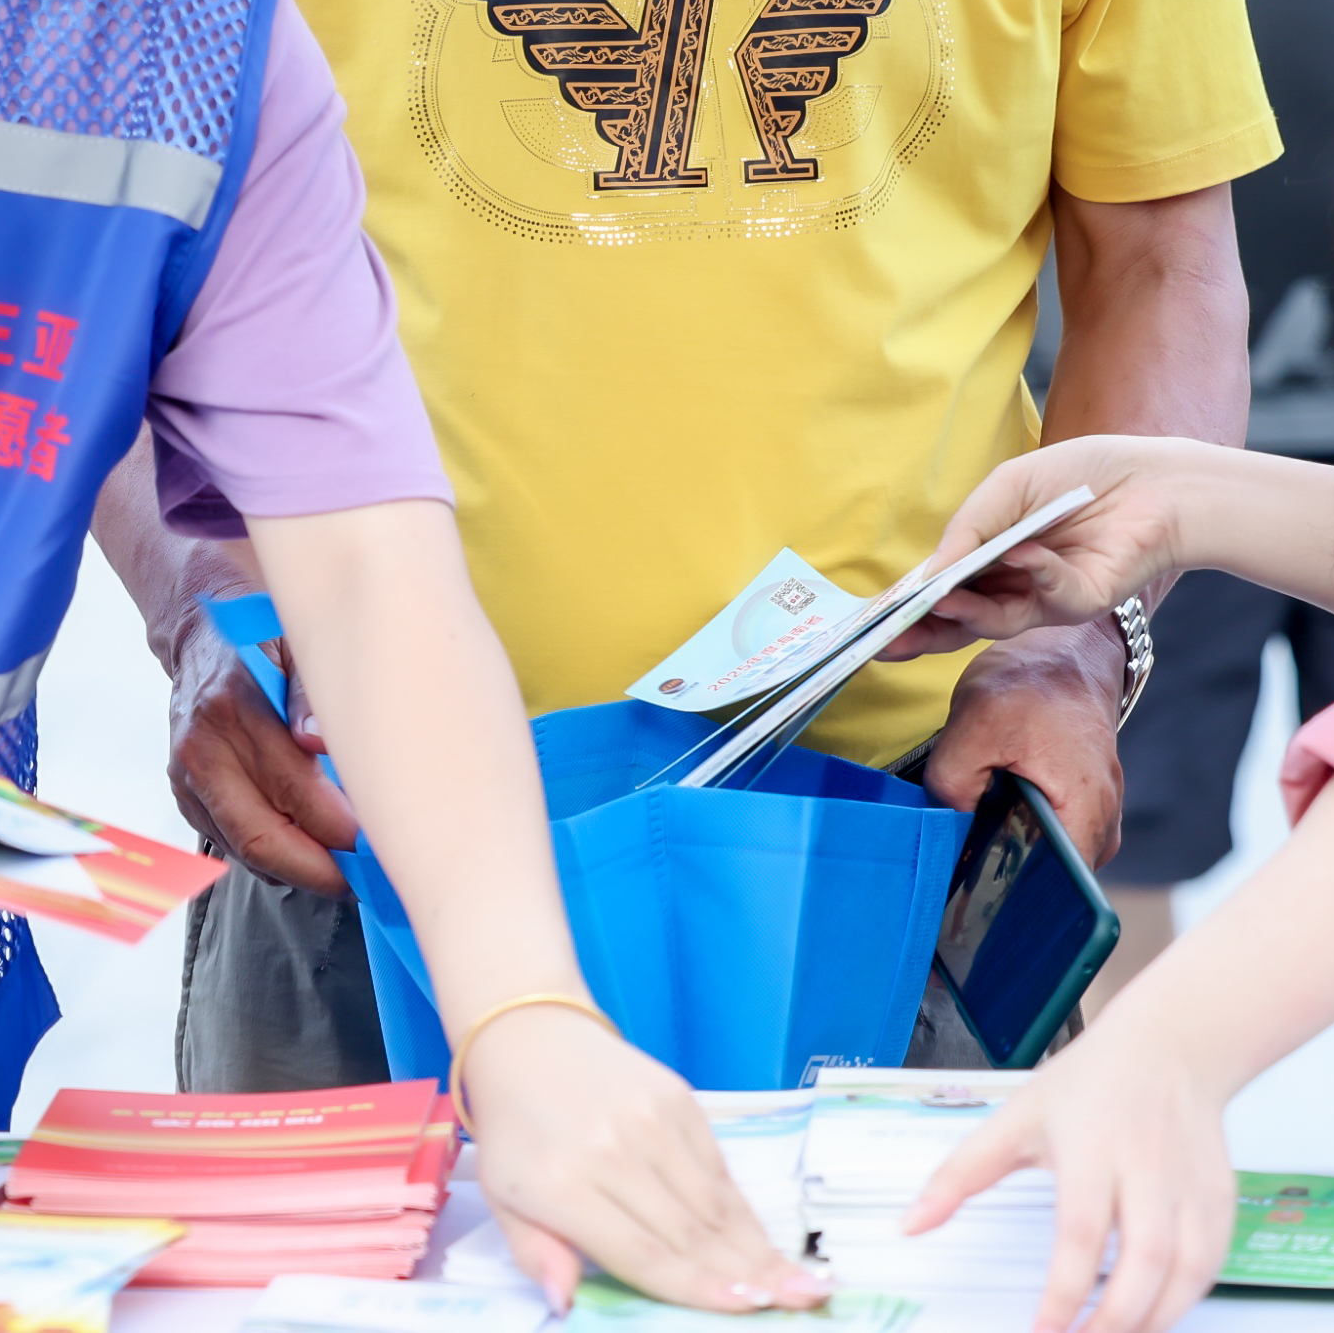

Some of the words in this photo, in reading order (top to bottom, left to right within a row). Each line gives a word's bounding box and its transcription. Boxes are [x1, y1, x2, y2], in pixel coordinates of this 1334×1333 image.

[707, 615, 824, 692] 2025年度海南省
